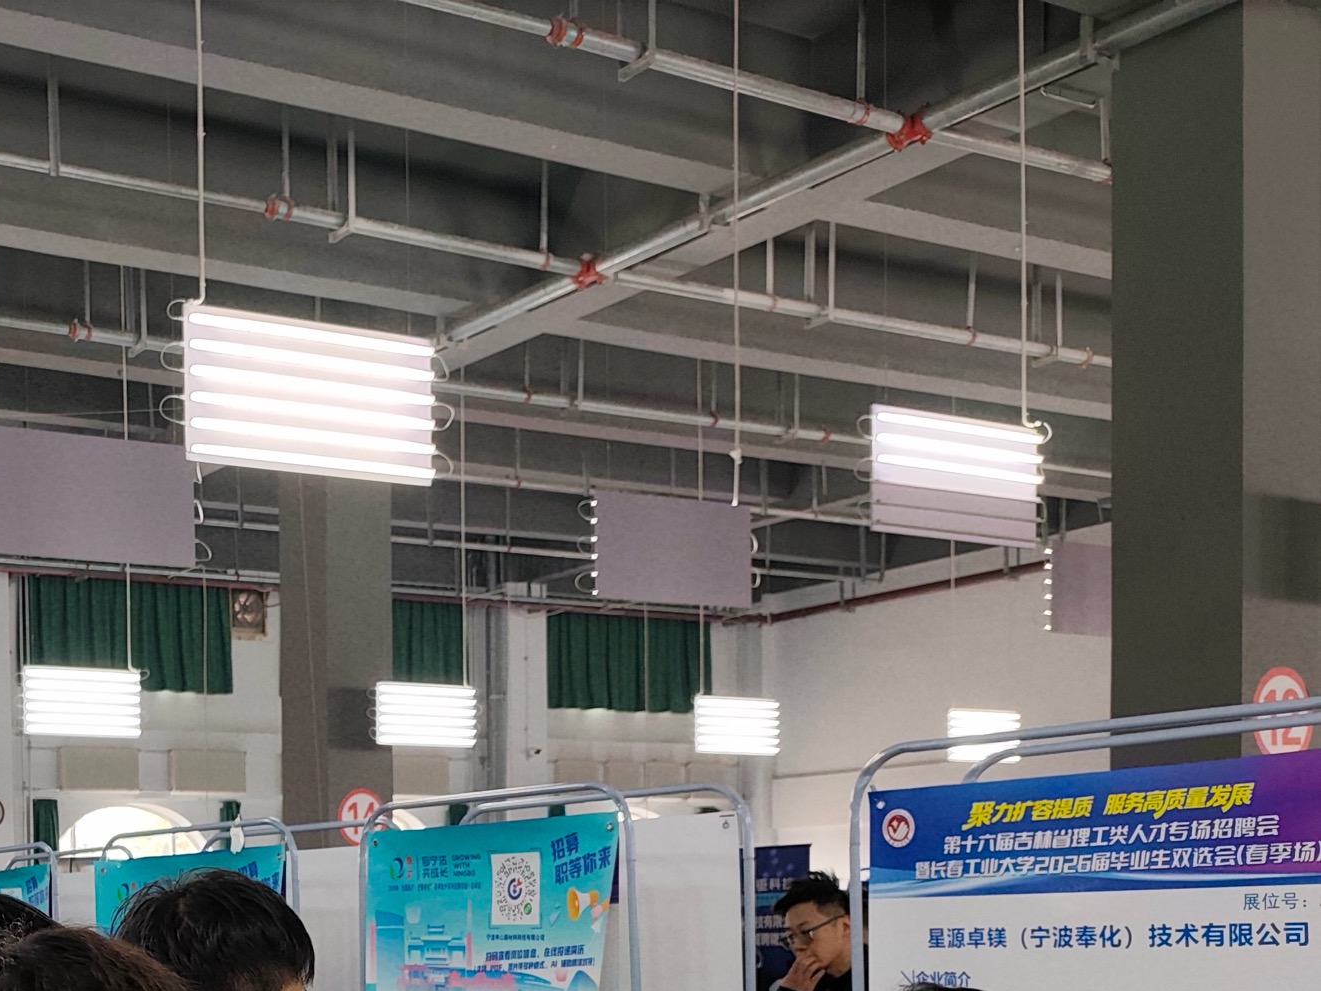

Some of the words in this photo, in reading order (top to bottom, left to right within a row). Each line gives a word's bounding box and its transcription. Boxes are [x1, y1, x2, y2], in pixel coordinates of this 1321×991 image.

[961, 796, 1095, 830] 聚力扩容提质
[1104, 782, 1255, 819] 服务高质量发展
[551, 832, 580, 860] 招募
[943, 815, 1280, 854] 第十六届吉林省理工类人才专场招聘会
[555, 846, 613, 886] 职等你来
[1243, 892, 1307, 911] 展位号：
[927, 922, 1310, 949] 星源卓镁（宁波奉化）技术有限公司
[916, 971, 971, 989] 企业简介
